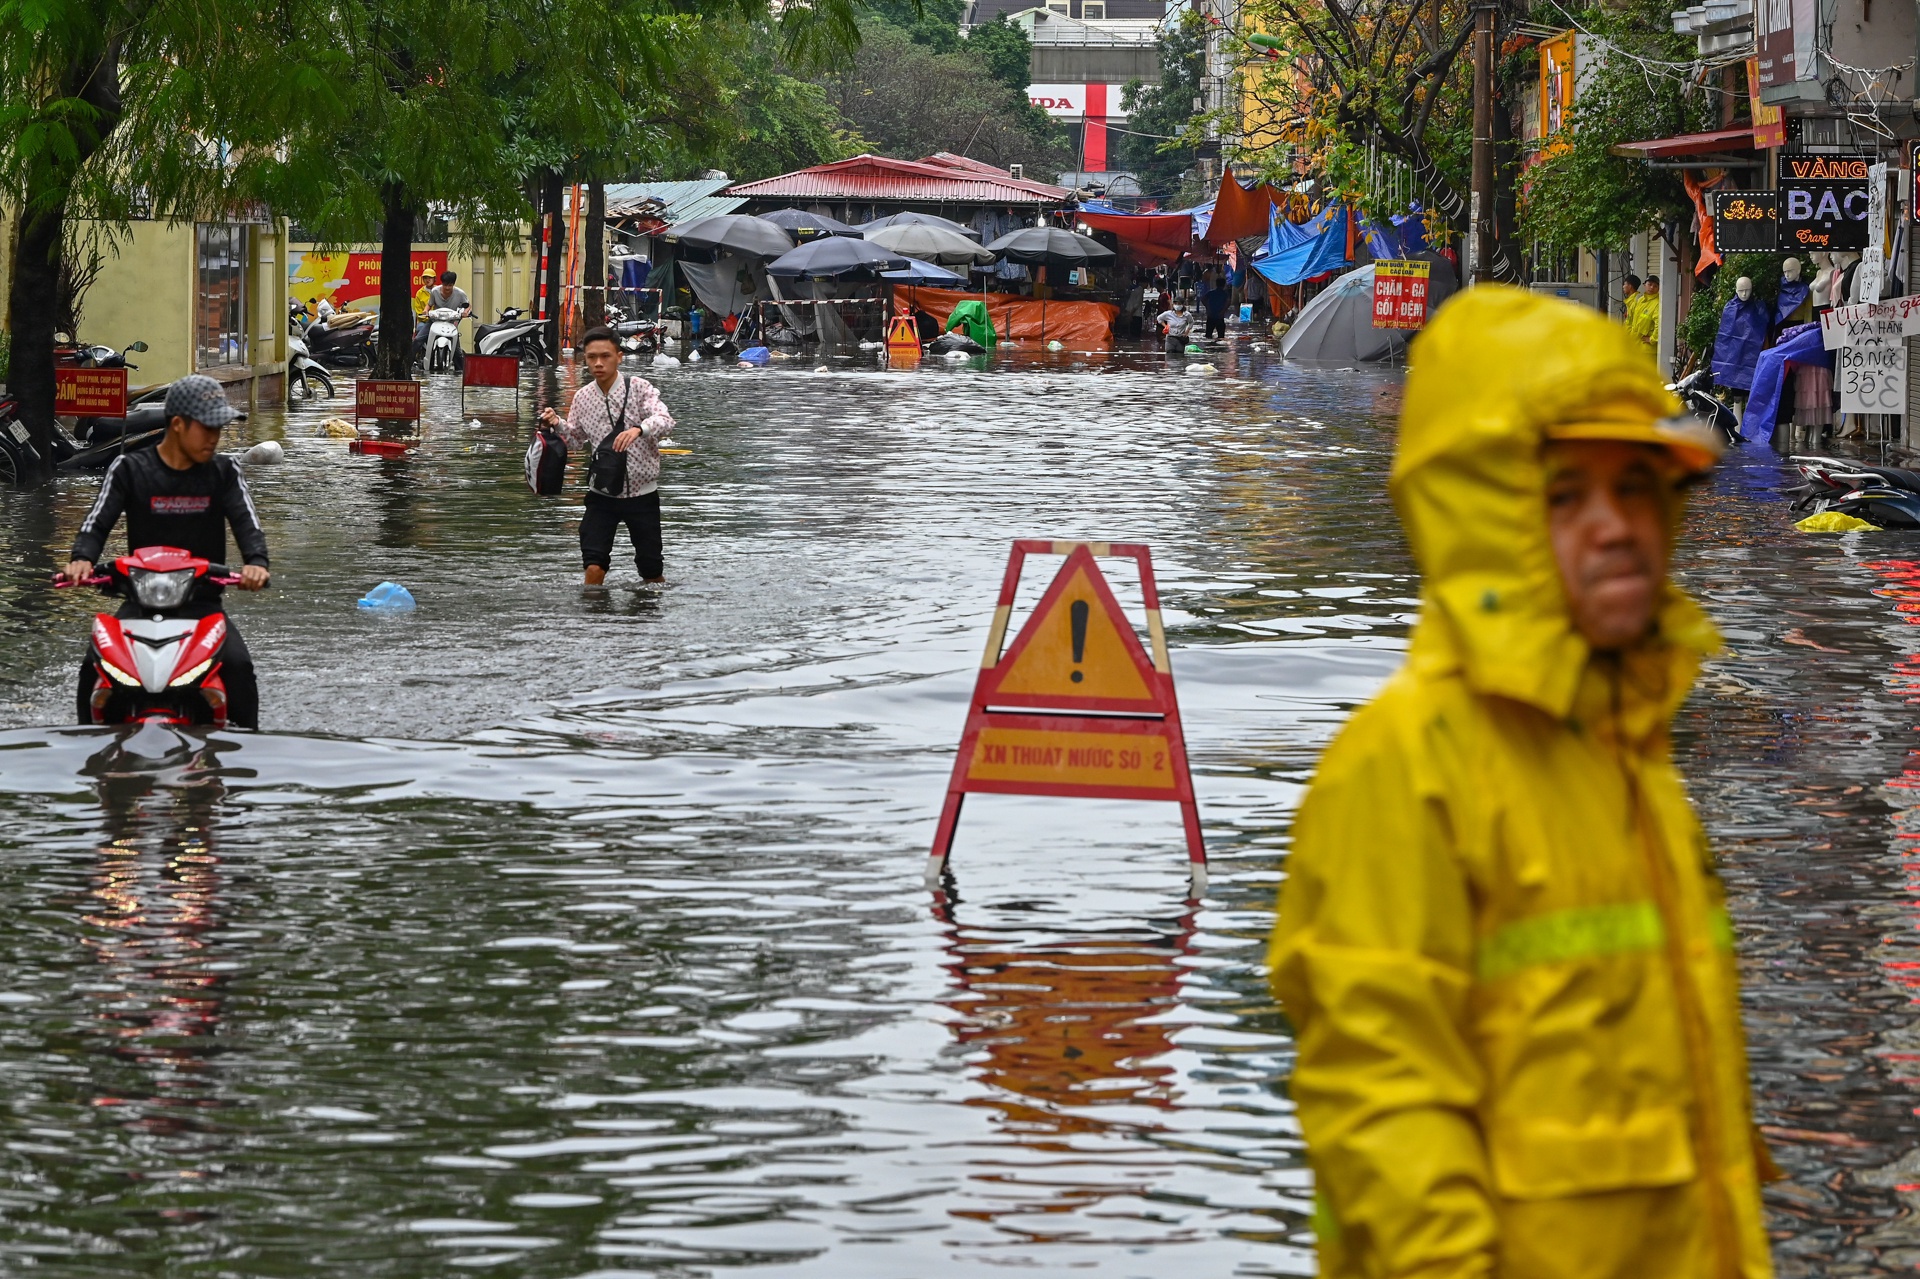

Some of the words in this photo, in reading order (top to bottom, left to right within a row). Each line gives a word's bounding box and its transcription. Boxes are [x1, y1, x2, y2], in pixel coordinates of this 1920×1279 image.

[1791, 158, 1867, 178] VÀNG
[1787, 190, 1869, 228] BẠC
[359, 258, 381, 270] PHÒN
[422, 258, 437, 270] TỐT
[1376, 279, 1402, 296] CHĂN
[1412, 283, 1424, 297] GA
[1376, 297, 1393, 315] GỐI
[1401, 300, 1422, 319] ĐỆM
[359, 386, 375, 405] CẤM
[983, 744, 1006, 764] XN
[1068, 744, 1114, 768] NƯỚC
[1119, 746, 1141, 769] SỐ
[1153, 752, 1164, 771] 2
